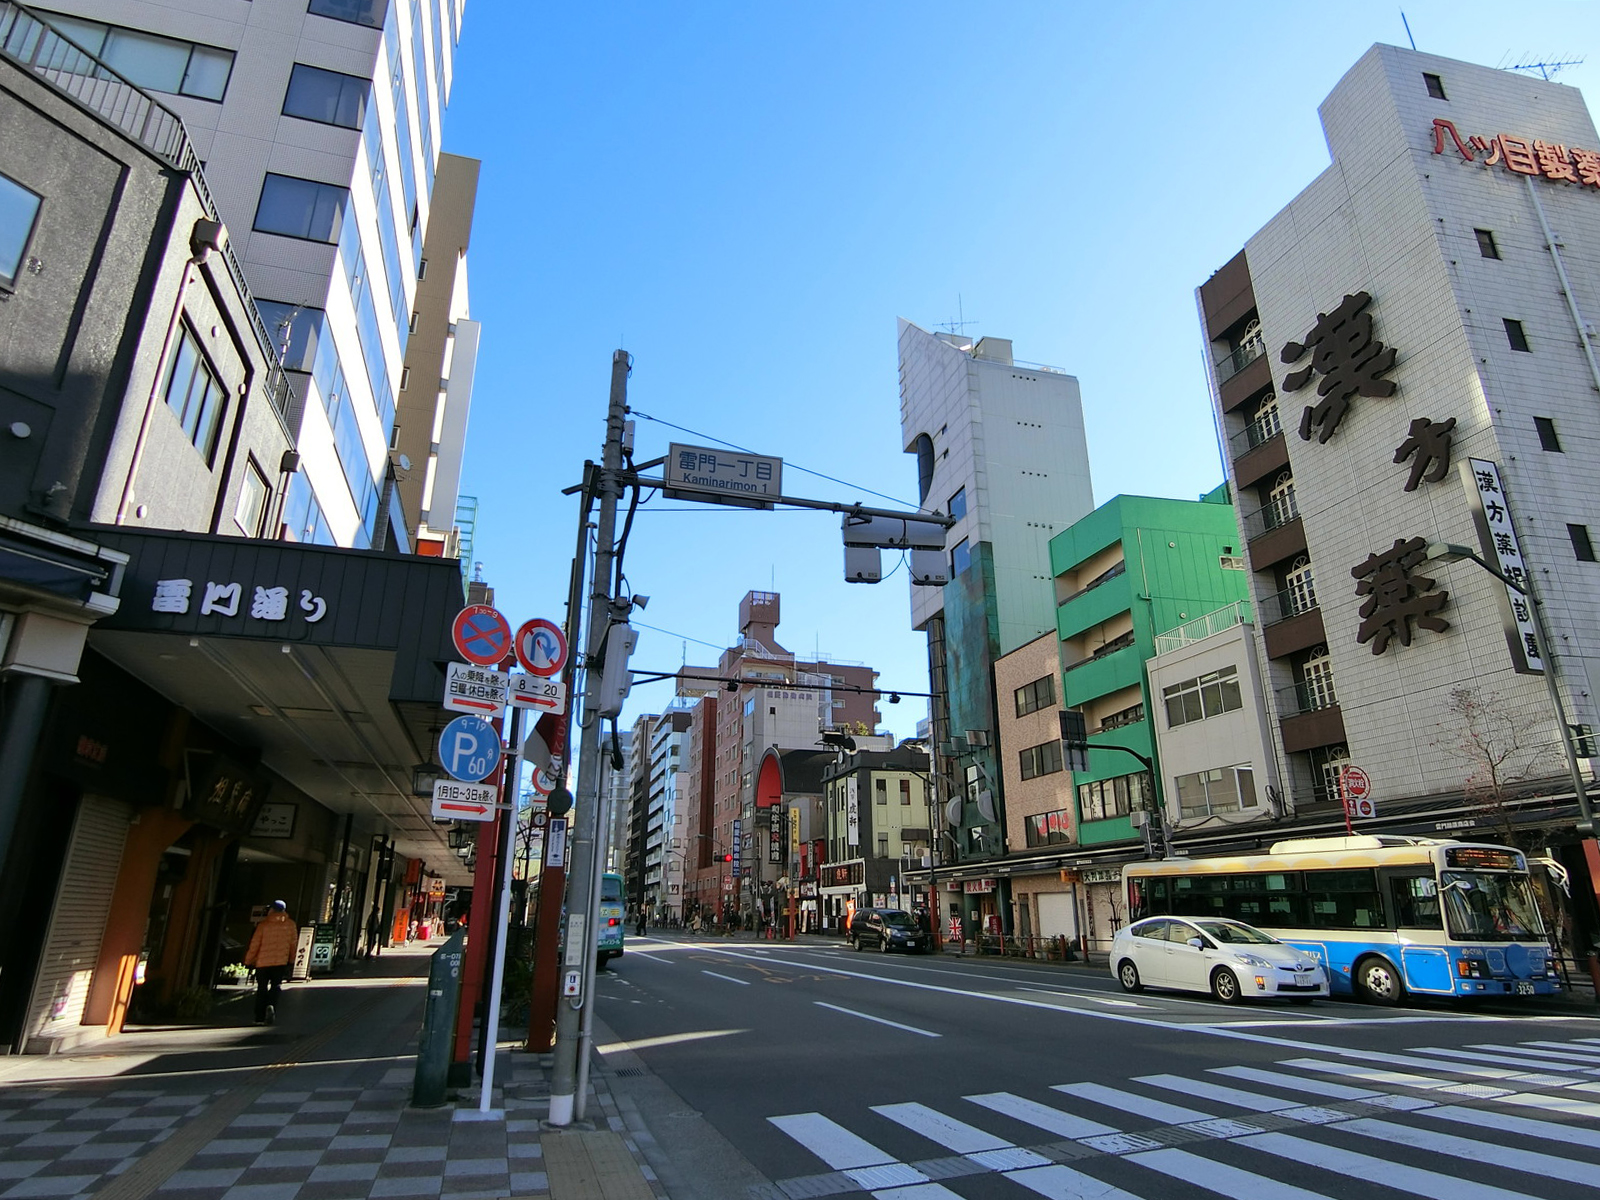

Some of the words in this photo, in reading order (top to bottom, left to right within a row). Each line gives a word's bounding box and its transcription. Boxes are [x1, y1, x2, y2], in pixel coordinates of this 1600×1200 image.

[679, 451, 772, 480] 雷門一丁目
[1281, 290, 1456, 656] 漢方薬
[683, 473, 757, 491] Kaminarimon
[762, 484, 768, 493] 1
[451, 667, 505, 687] 人の乗降を除く
[452, 731, 478, 773] P
[468, 756, 486, 775] 60
